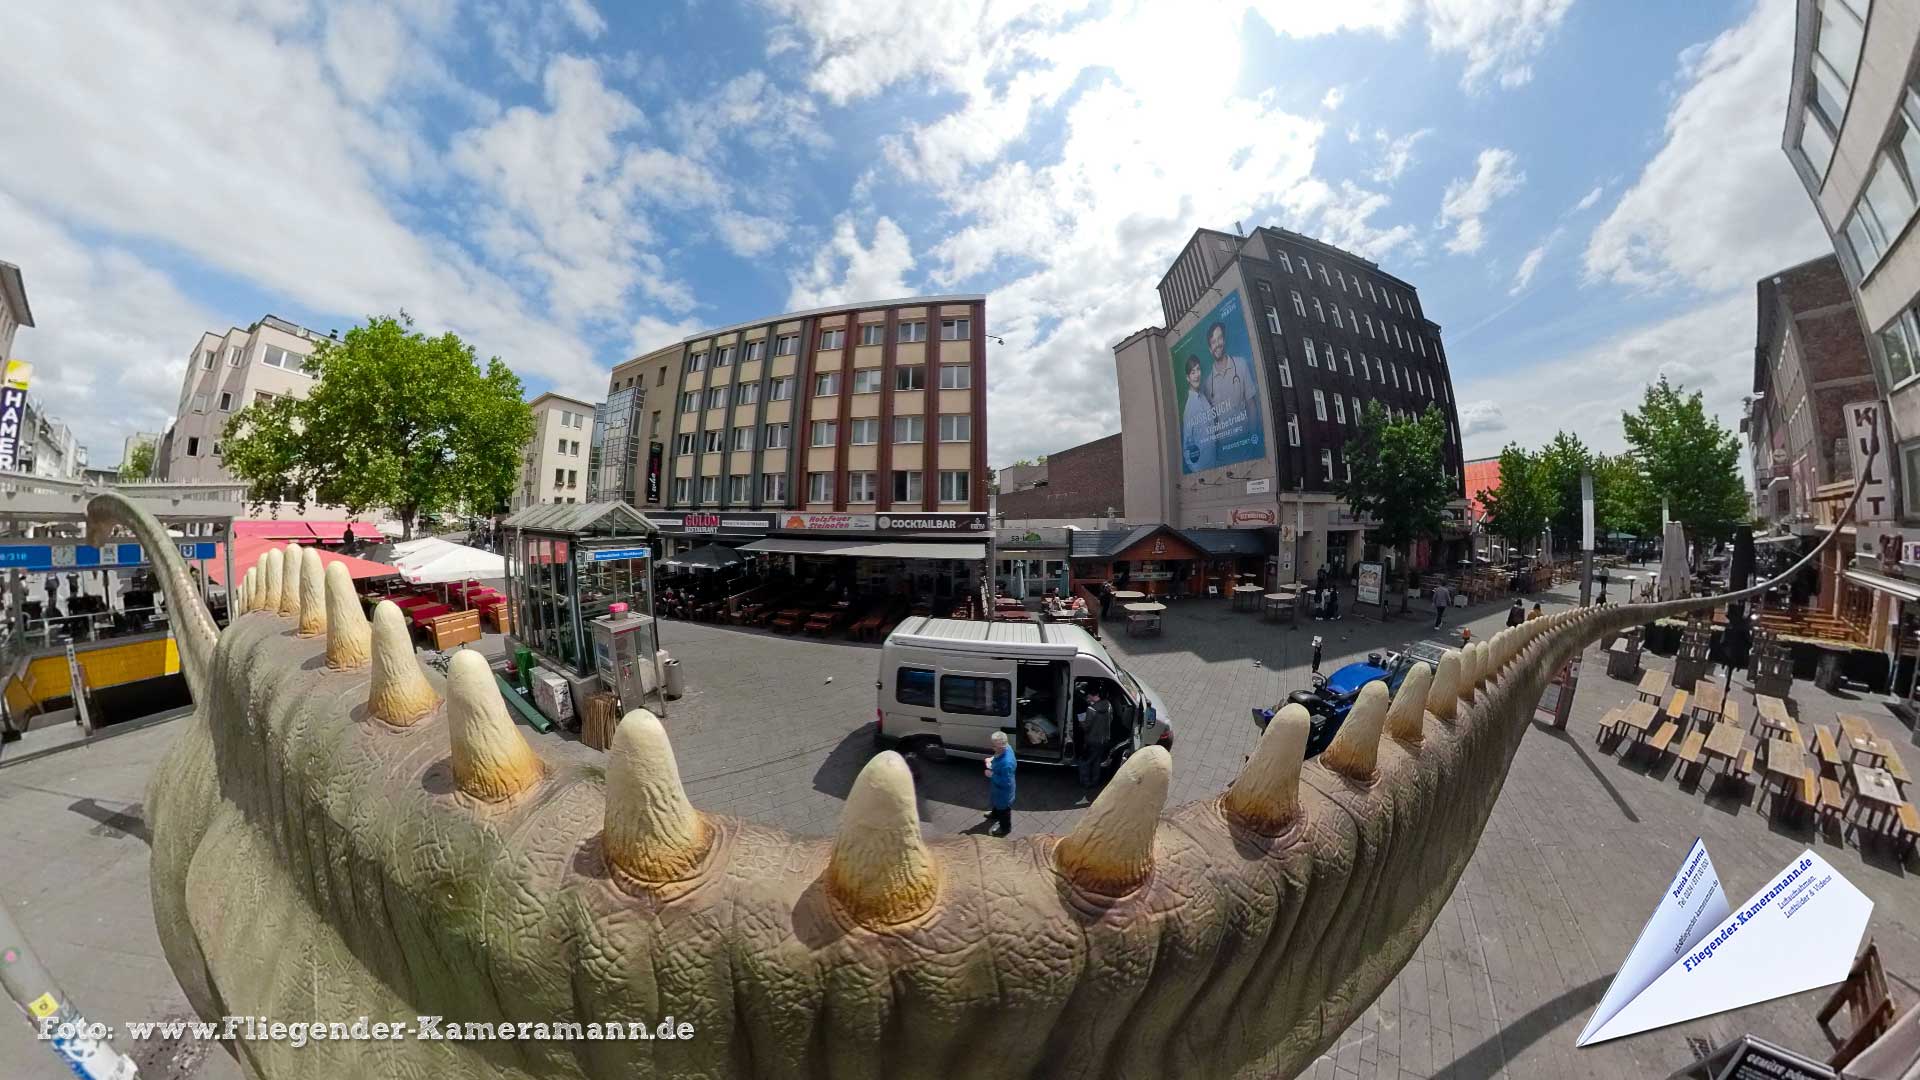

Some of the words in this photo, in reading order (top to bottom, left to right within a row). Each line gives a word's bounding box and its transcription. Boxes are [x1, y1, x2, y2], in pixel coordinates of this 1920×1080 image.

[0, 391, 21, 470] HAMER
[1853, 406, 1886, 516] KULT
[891, 519, 957, 529] COCKTAILBAR
